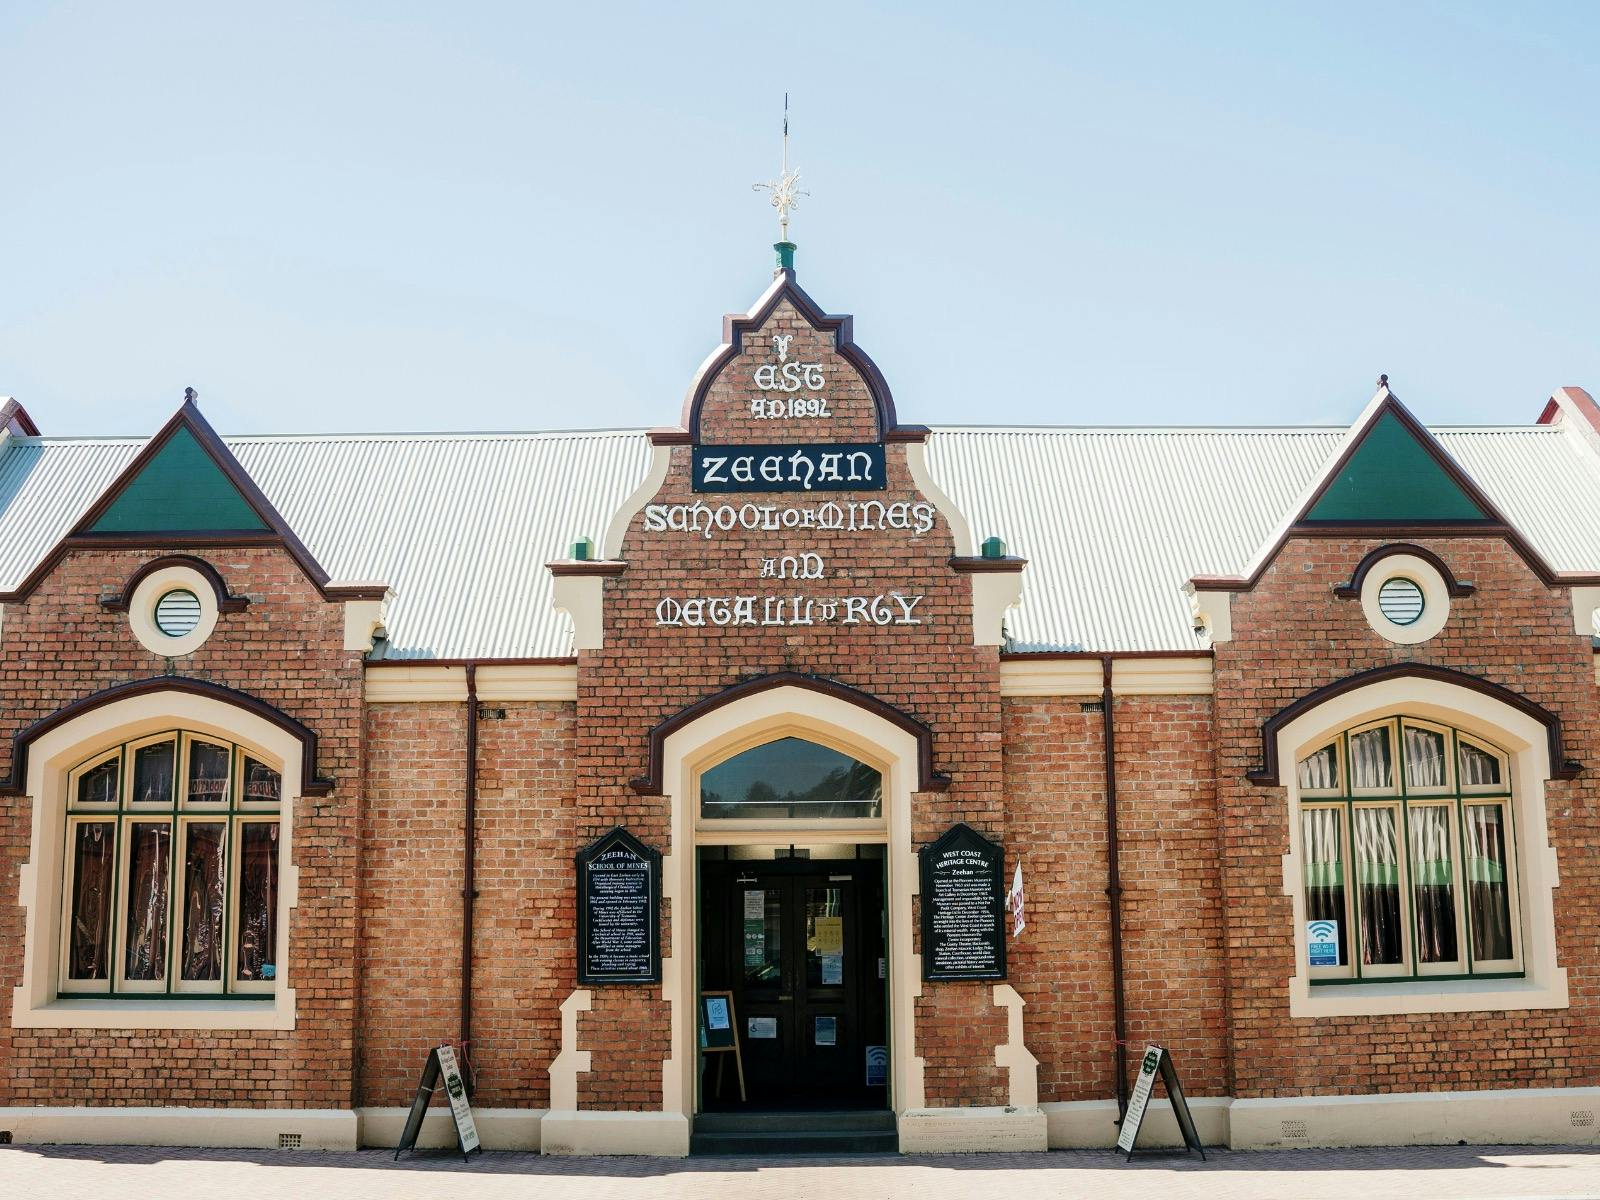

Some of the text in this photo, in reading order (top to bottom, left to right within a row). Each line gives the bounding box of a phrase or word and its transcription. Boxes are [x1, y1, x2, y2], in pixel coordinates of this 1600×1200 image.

[753, 361, 825, 392] EST
[702, 449, 873, 489] ZEEHAN
[644, 500, 935, 538] SCHOOL OF MINES
[760, 552, 825, 579] AND
[601, 851, 636, 861] ZEEHAN
[936, 858, 989, 869] HERITAGE CENTRE
[942, 850, 981, 858] WEST COAST
